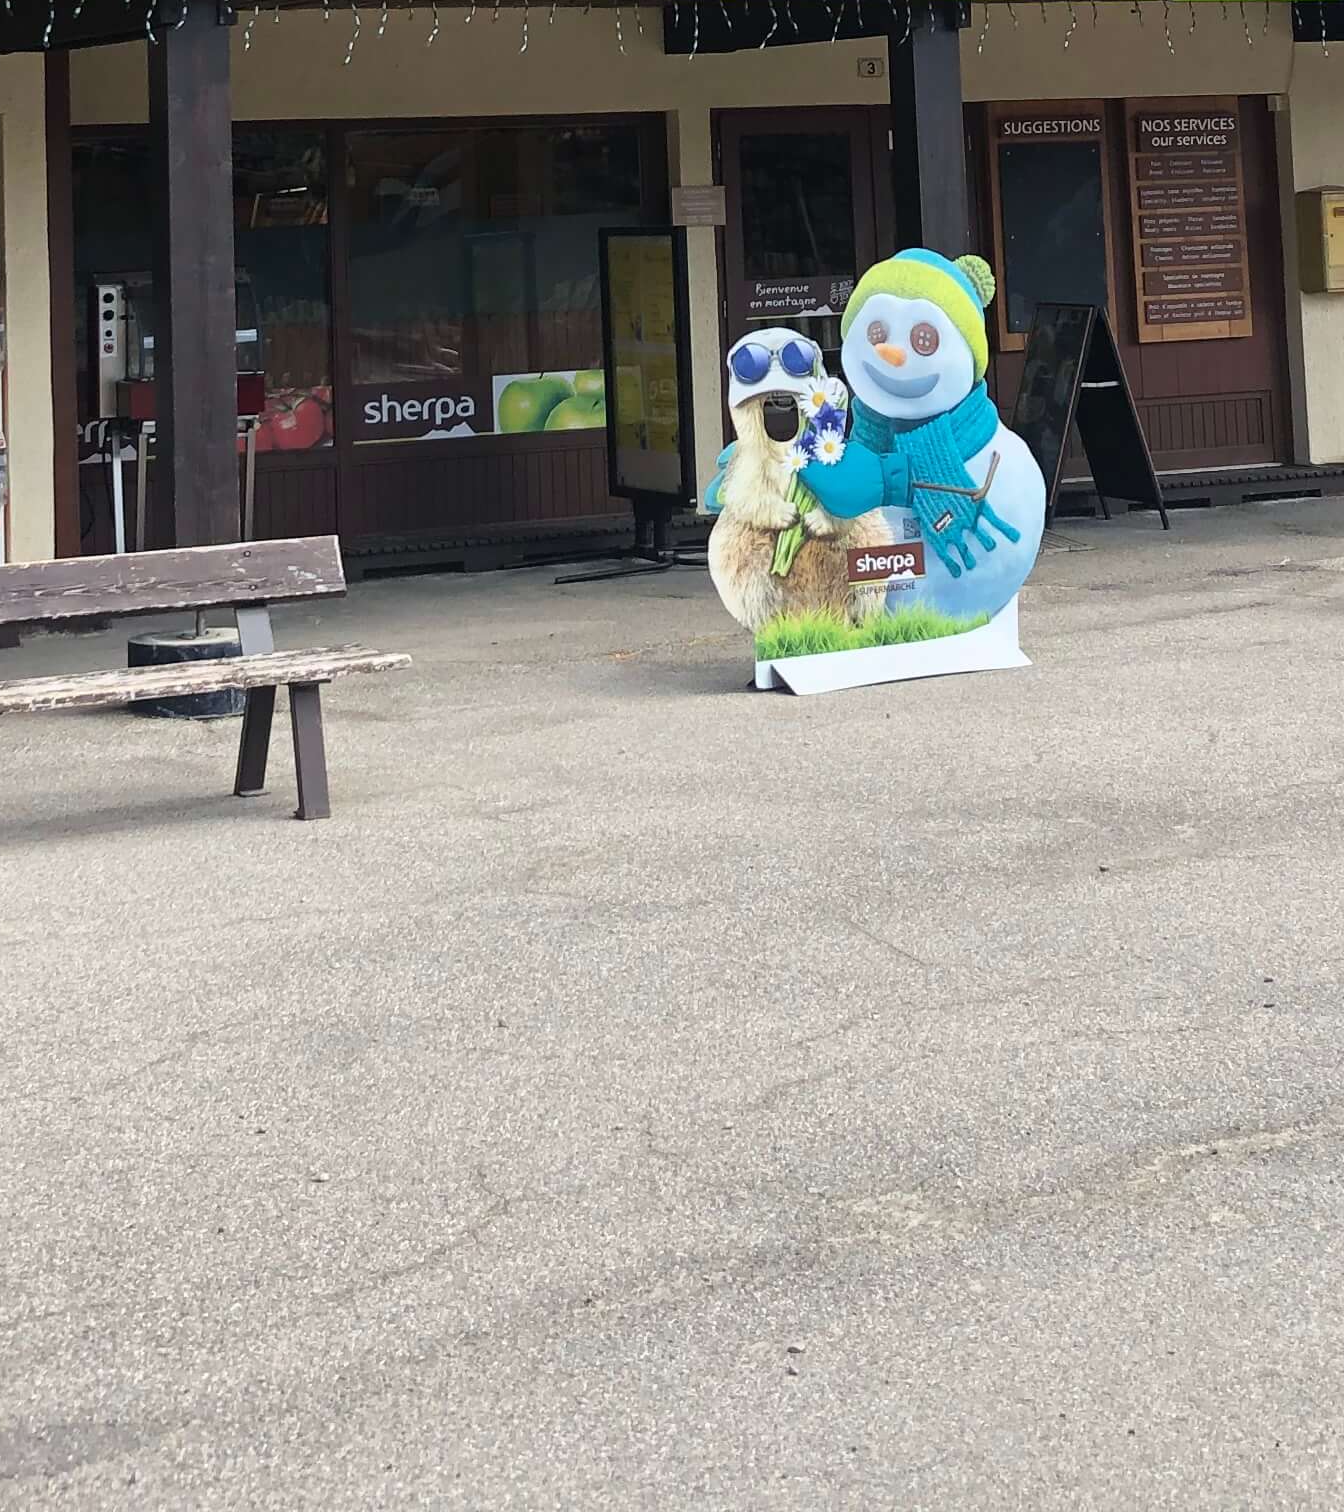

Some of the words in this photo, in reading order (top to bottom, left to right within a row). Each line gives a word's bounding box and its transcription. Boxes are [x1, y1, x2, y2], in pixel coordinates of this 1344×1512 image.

[867, 62, 876, 75] 3
[1003, 119, 1101, 135] SUGGESTIONS
[1141, 119, 1171, 133] NOS
[1174, 117, 1235, 132] SERVICES
[1151, 135, 1174, 147] our
[1176, 133, 1227, 146] services
[756, 283, 809, 297] Bienvenue
[750, 300, 762, 309] en
[765, 296, 817, 309] montagne
[364, 394, 475, 425] sherpa
[856, 553, 916, 572] sherpa
